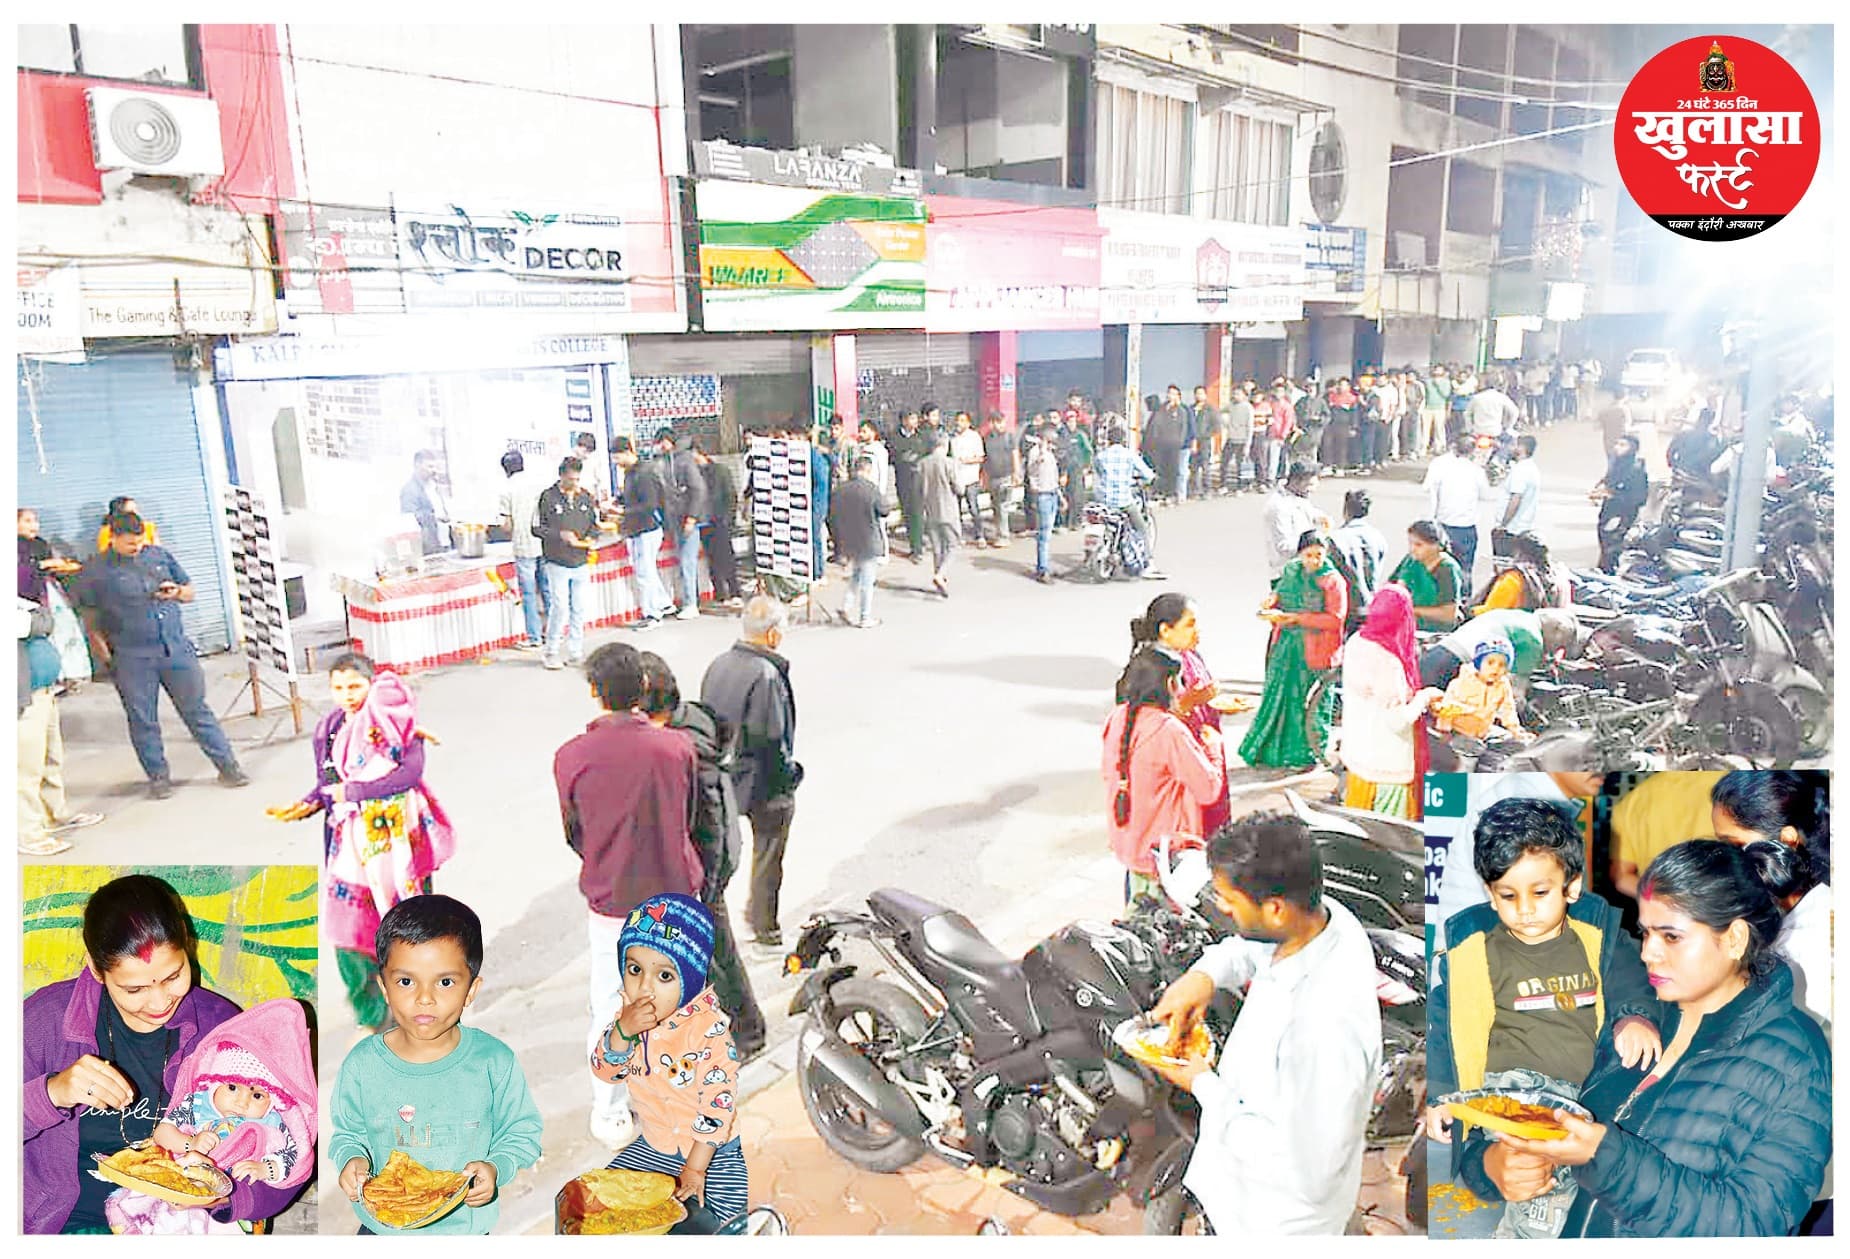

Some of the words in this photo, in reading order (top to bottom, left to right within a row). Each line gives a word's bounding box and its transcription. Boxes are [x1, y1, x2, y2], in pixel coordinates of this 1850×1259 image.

[524, 247, 623, 272] DECOR
[17, 291, 55, 309] FICE
[89, 306, 112, 323] The
[116, 306, 165, 327] Gaming
[213, 306, 257, 328] Lounge
[1517, 971, 1596, 998] ORGINA
